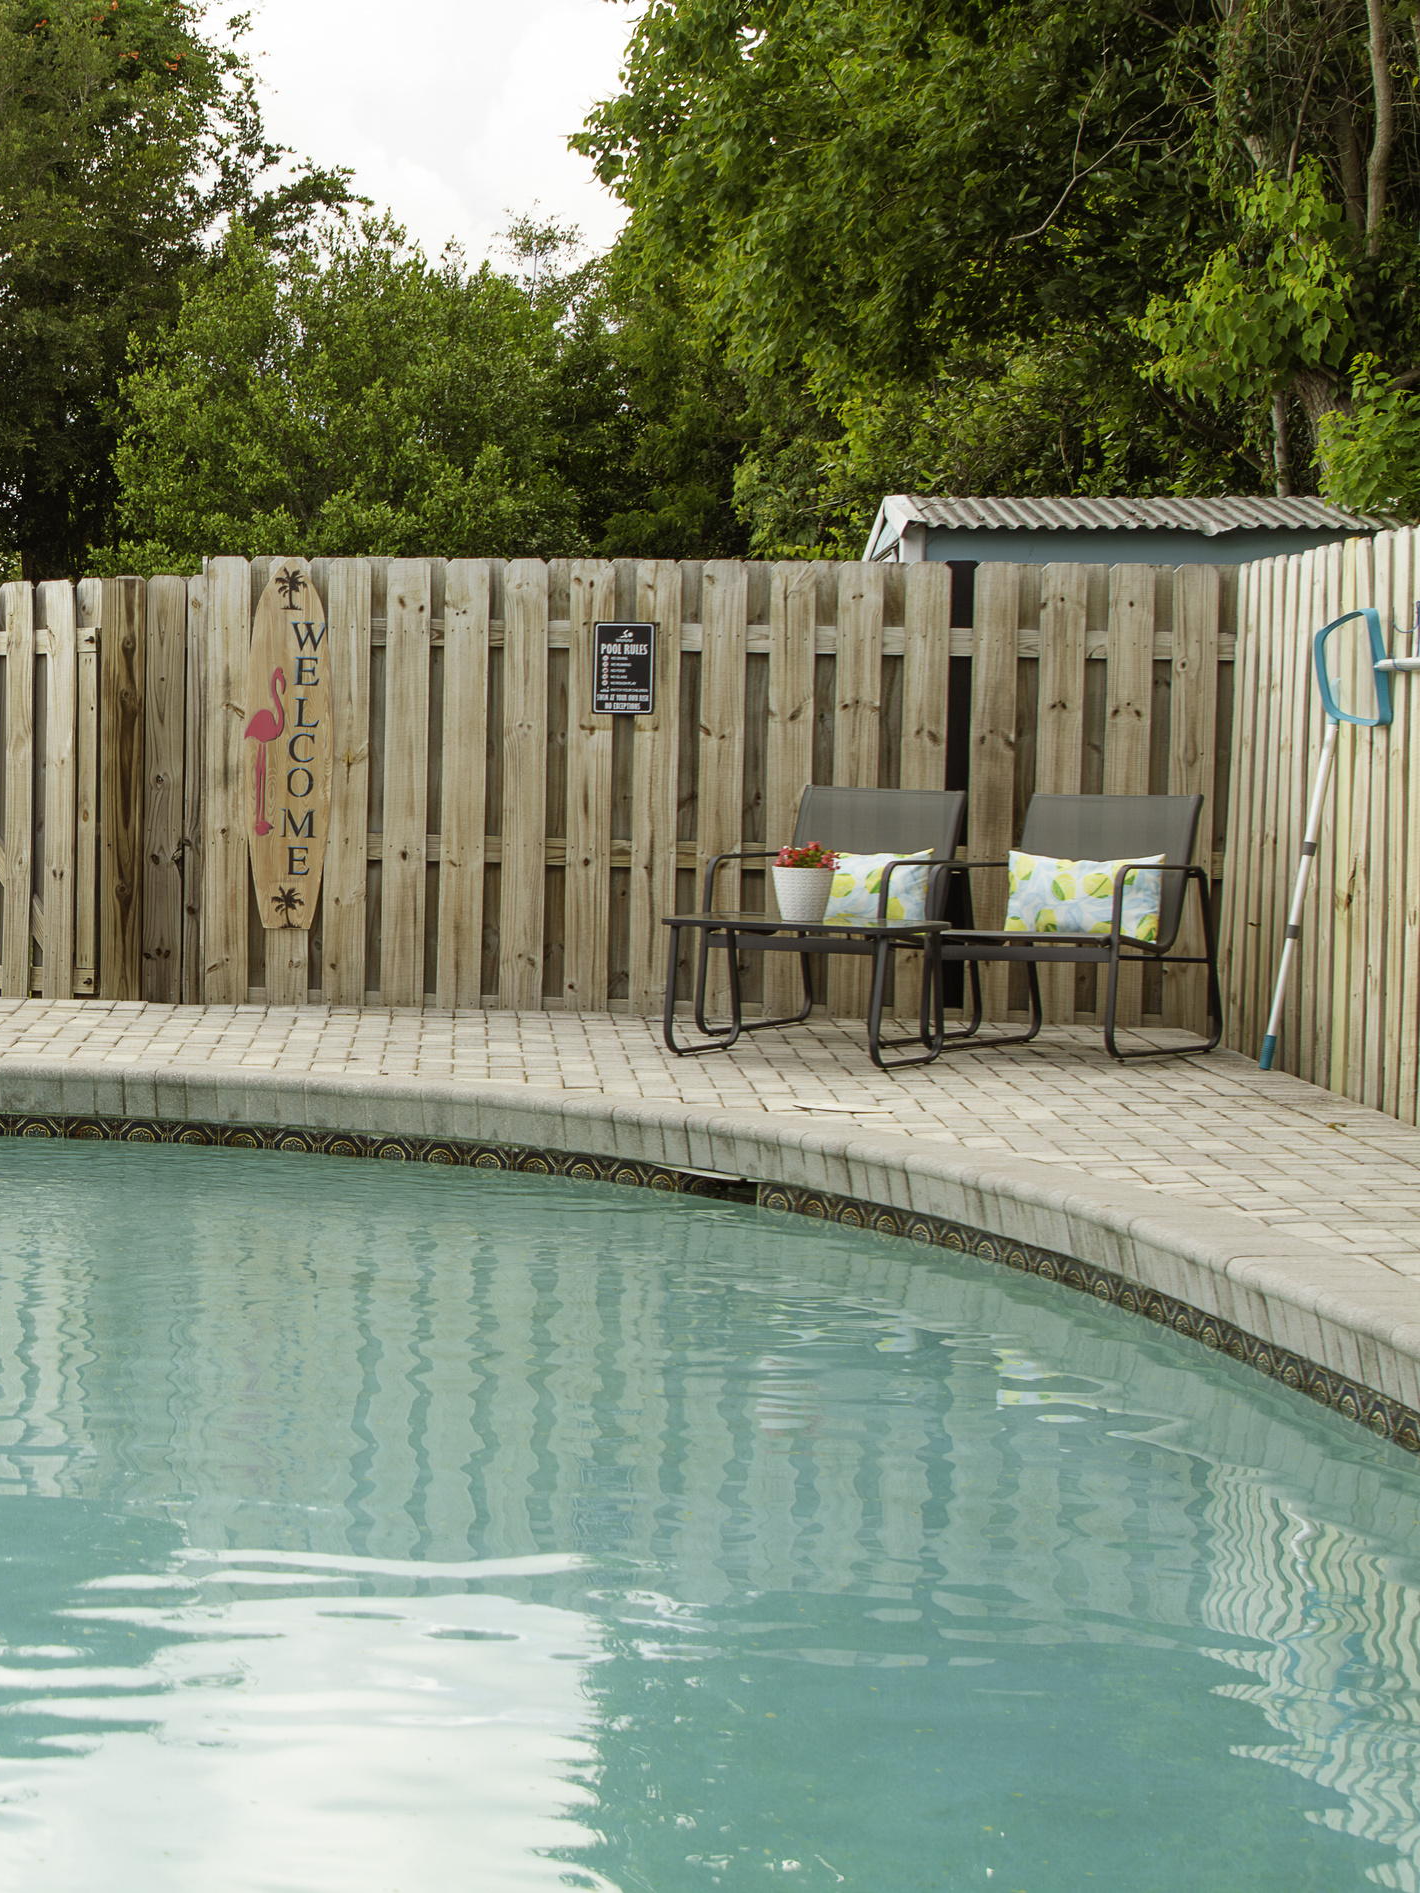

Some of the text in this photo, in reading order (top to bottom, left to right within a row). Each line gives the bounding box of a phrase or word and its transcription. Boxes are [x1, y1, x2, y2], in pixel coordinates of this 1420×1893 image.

[600, 644, 648, 655] POOL RULES
[281, 621, 326, 876] WELCOME
